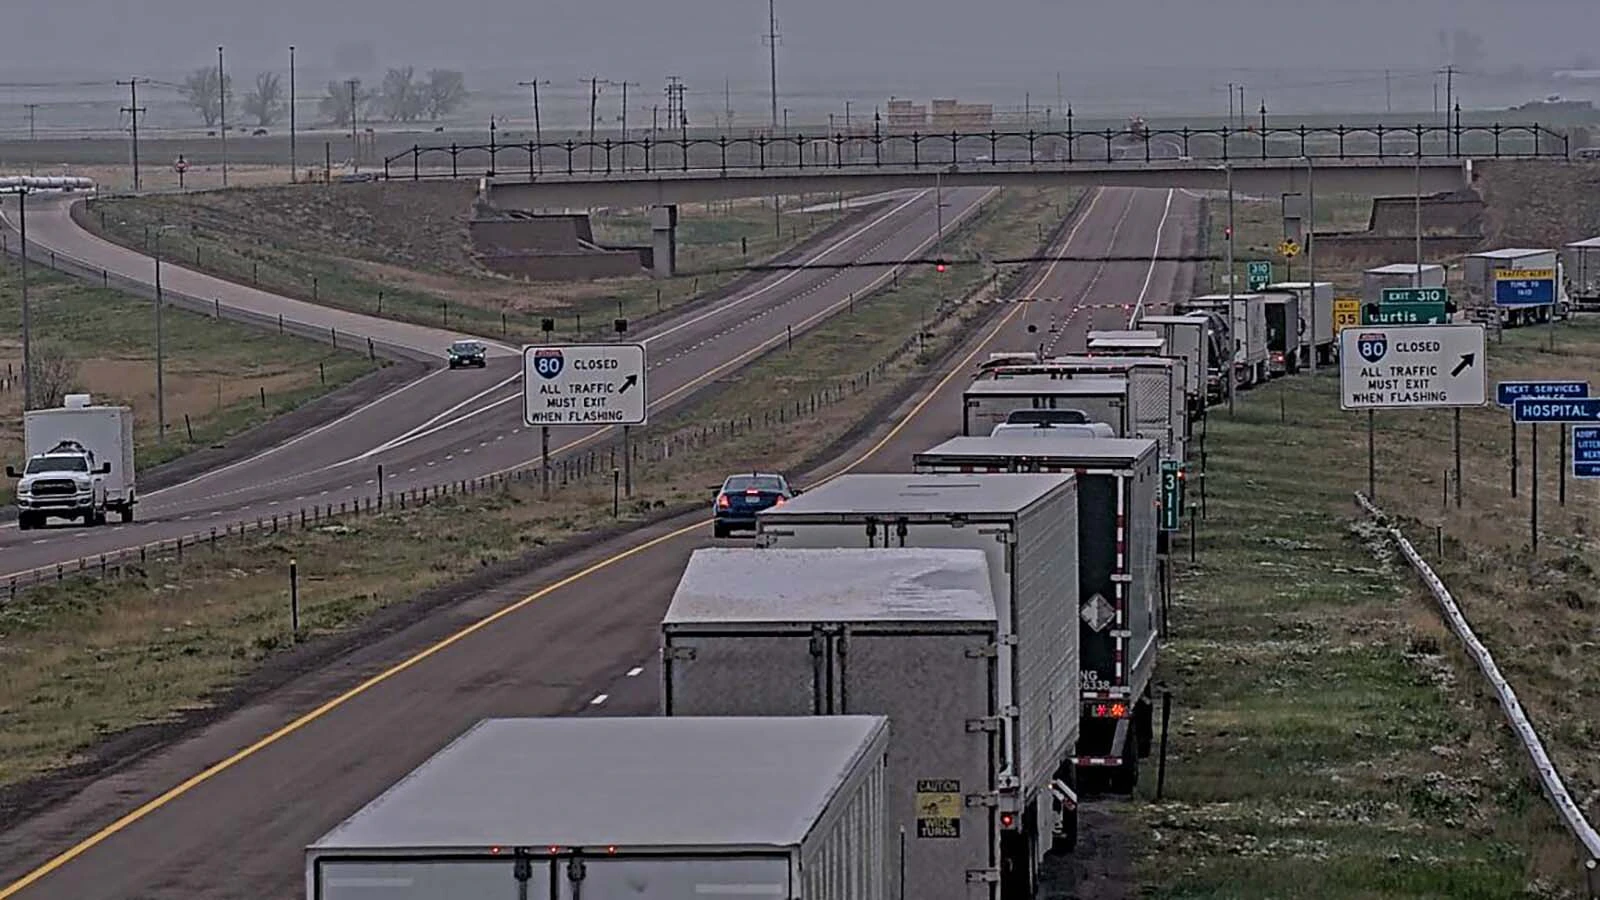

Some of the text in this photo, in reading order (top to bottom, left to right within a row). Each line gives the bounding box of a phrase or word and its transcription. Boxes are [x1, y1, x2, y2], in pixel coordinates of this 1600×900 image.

[1389, 290, 1440, 301] EXIT 310
[1338, 313, 1356, 325] 35
[1362, 341, 1440, 357] 80 CLOSED
[538, 358, 618, 374] 80 CLOSED
[1360, 366, 1438, 378] ALL TRAFFIC
[540, 383, 614, 395] ALL TRAFFIC
[1368, 379, 1430, 390] MUST EXIT
[1505, 384, 1581, 394] NEXT SERVICES
[547, 397, 607, 408] MUST EXIT
[1352, 391, 1447, 404] WHEN FLASHING
[532, 410, 623, 423] WHEN FLASHING
[1522, 404, 1590, 417] HOSPITAL
[919, 780, 958, 791] CAUTION
